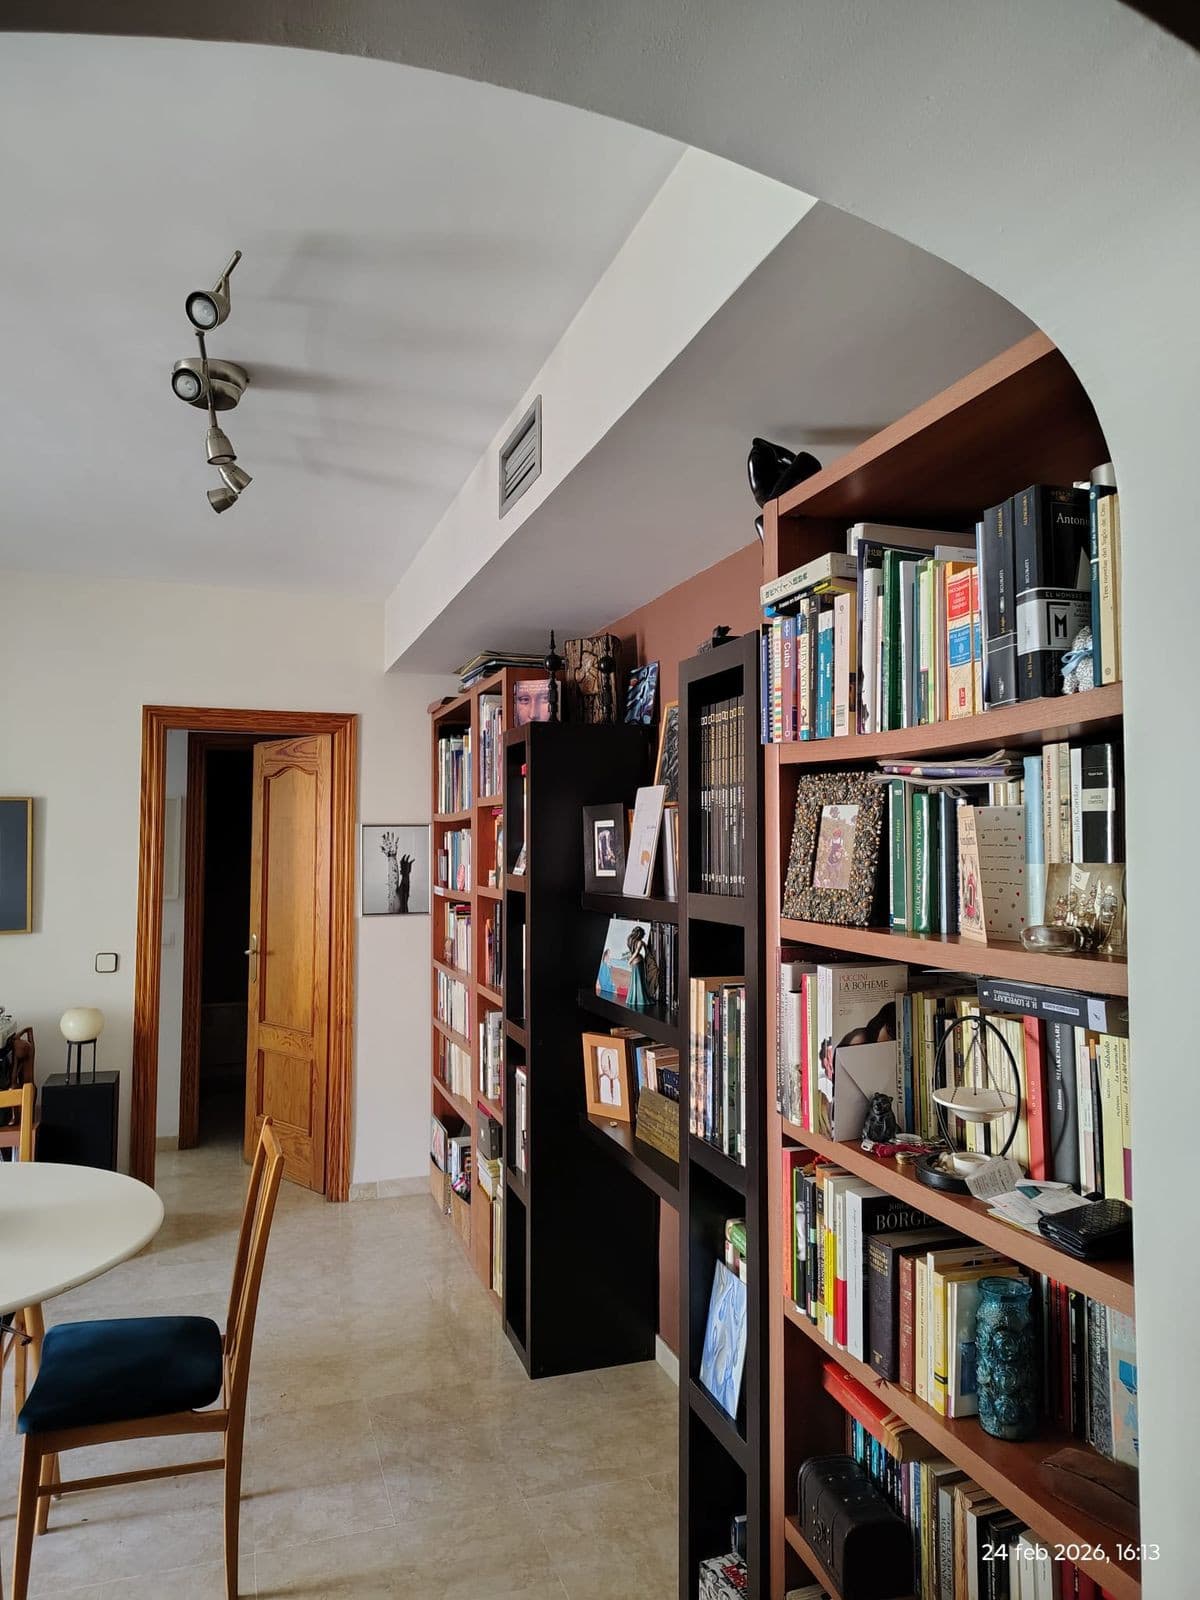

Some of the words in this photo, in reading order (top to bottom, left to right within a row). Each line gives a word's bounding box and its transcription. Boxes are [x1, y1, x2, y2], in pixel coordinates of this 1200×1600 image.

[1054, 613, 1067, 638] M
[800, 637, 808, 671] NUEVA
[800, 674, 808, 700] YORK
[1073, 816, 1081, 833] Julio
[915, 840, 922, 848] Y
[915, 883, 922, 894] DE
[840, 982, 850, 991] LA
[993, 993, 1025, 1008] LOVECRAFT
[1103, 1041, 1111, 1070] Sábado
